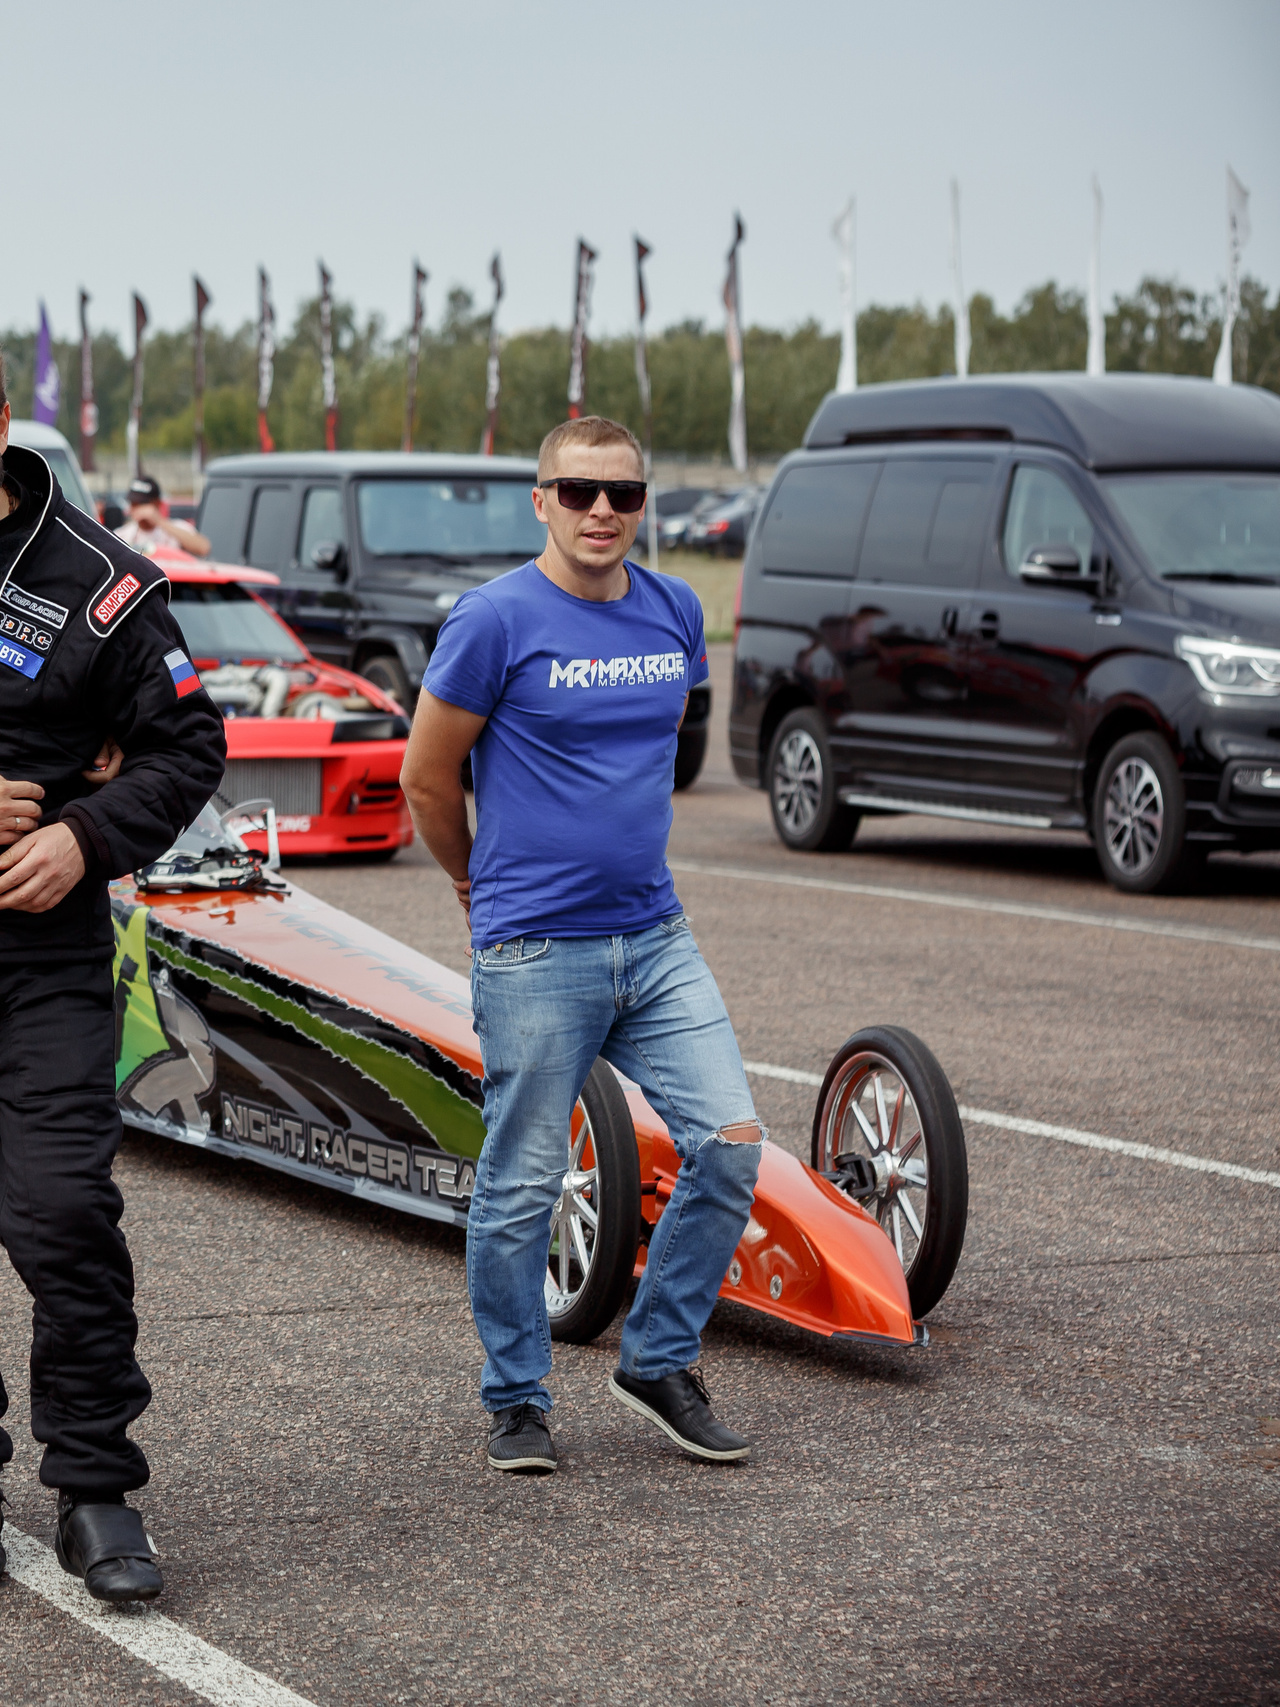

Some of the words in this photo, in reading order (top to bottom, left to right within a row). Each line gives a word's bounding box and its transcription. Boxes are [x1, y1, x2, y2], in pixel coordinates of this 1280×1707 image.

[29, 600, 65, 624] RACING
[98, 576, 137, 621] SIMPSON
[597, 671, 685, 688] MOTORSPORT
[224, 1100, 304, 1158] NIGHT
[310, 1126, 409, 1186] RACER
[414, 1154, 477, 1199] TEA
